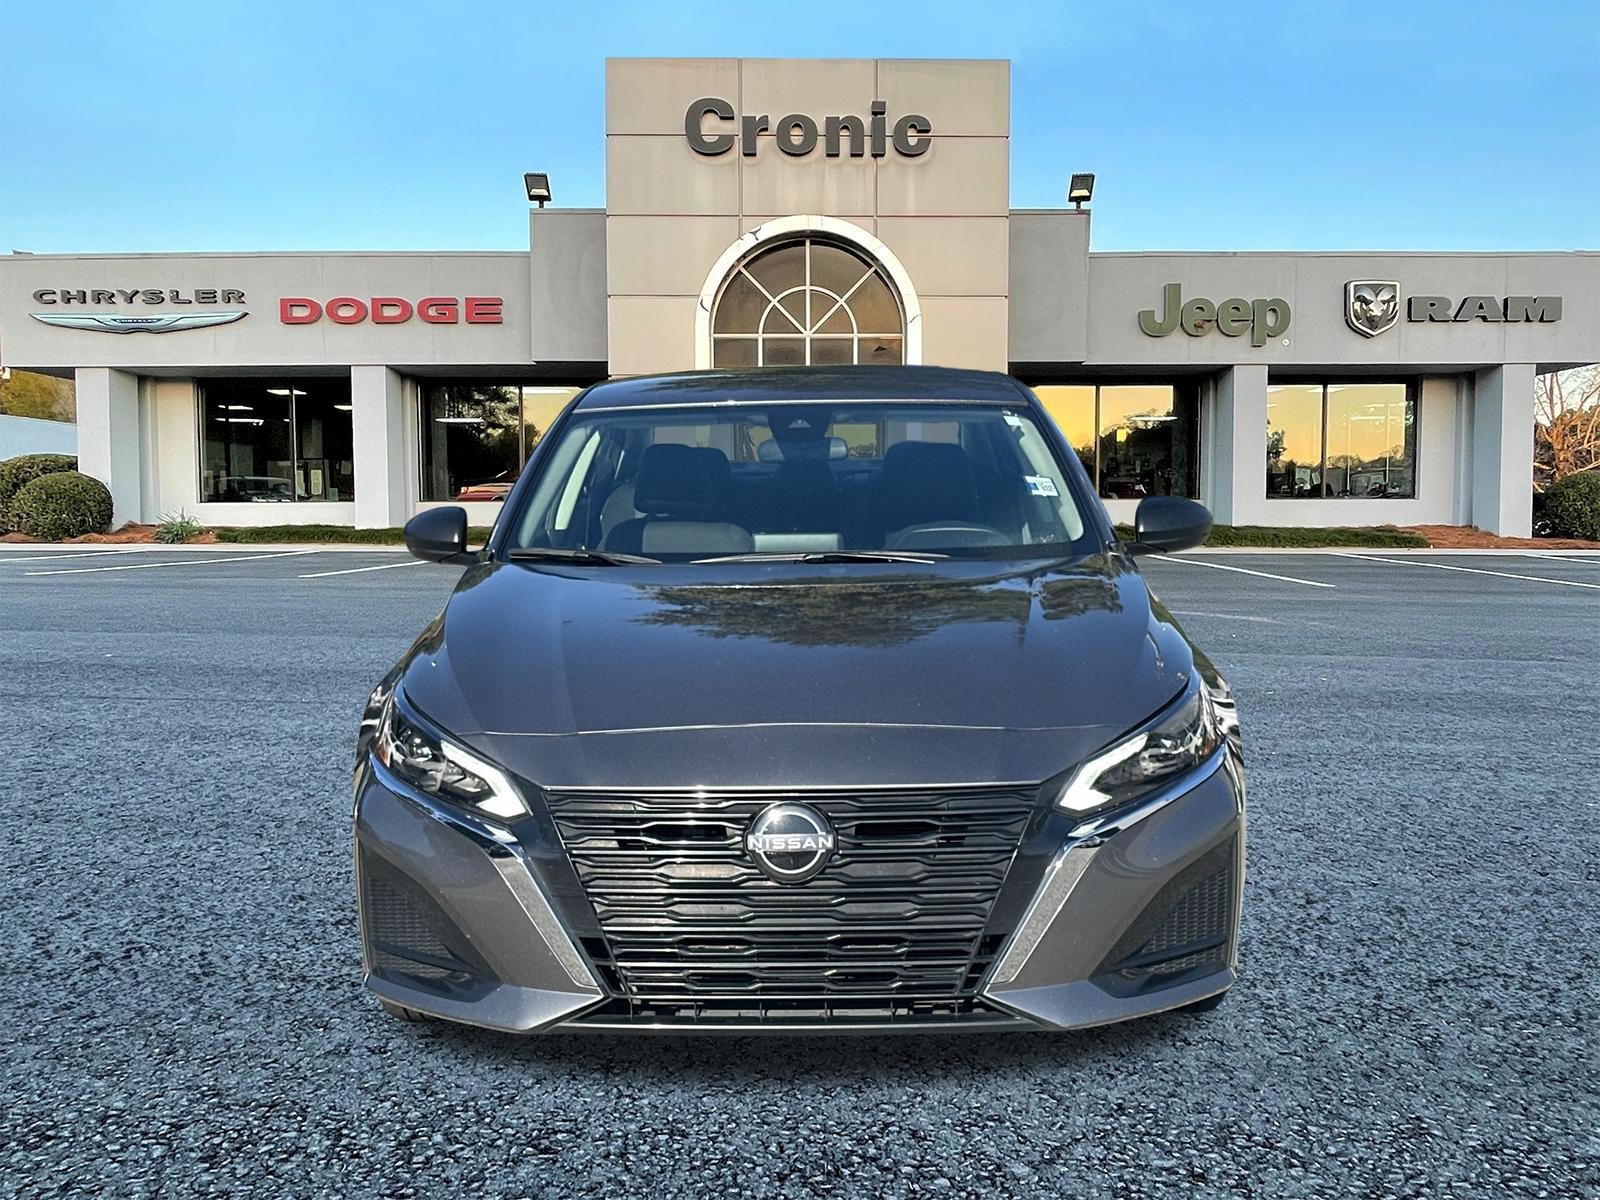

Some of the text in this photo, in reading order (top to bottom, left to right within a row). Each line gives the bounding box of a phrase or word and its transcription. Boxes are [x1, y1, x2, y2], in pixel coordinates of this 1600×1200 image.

[685, 97, 932, 158] Cronic
[32, 288, 247, 305] CHRYSLER
[1408, 296, 1563, 323] RAM
[280, 297, 503, 325] DODGE
[1138, 283, 1291, 347] Jeep
[748, 836, 833, 849] NISSAN
